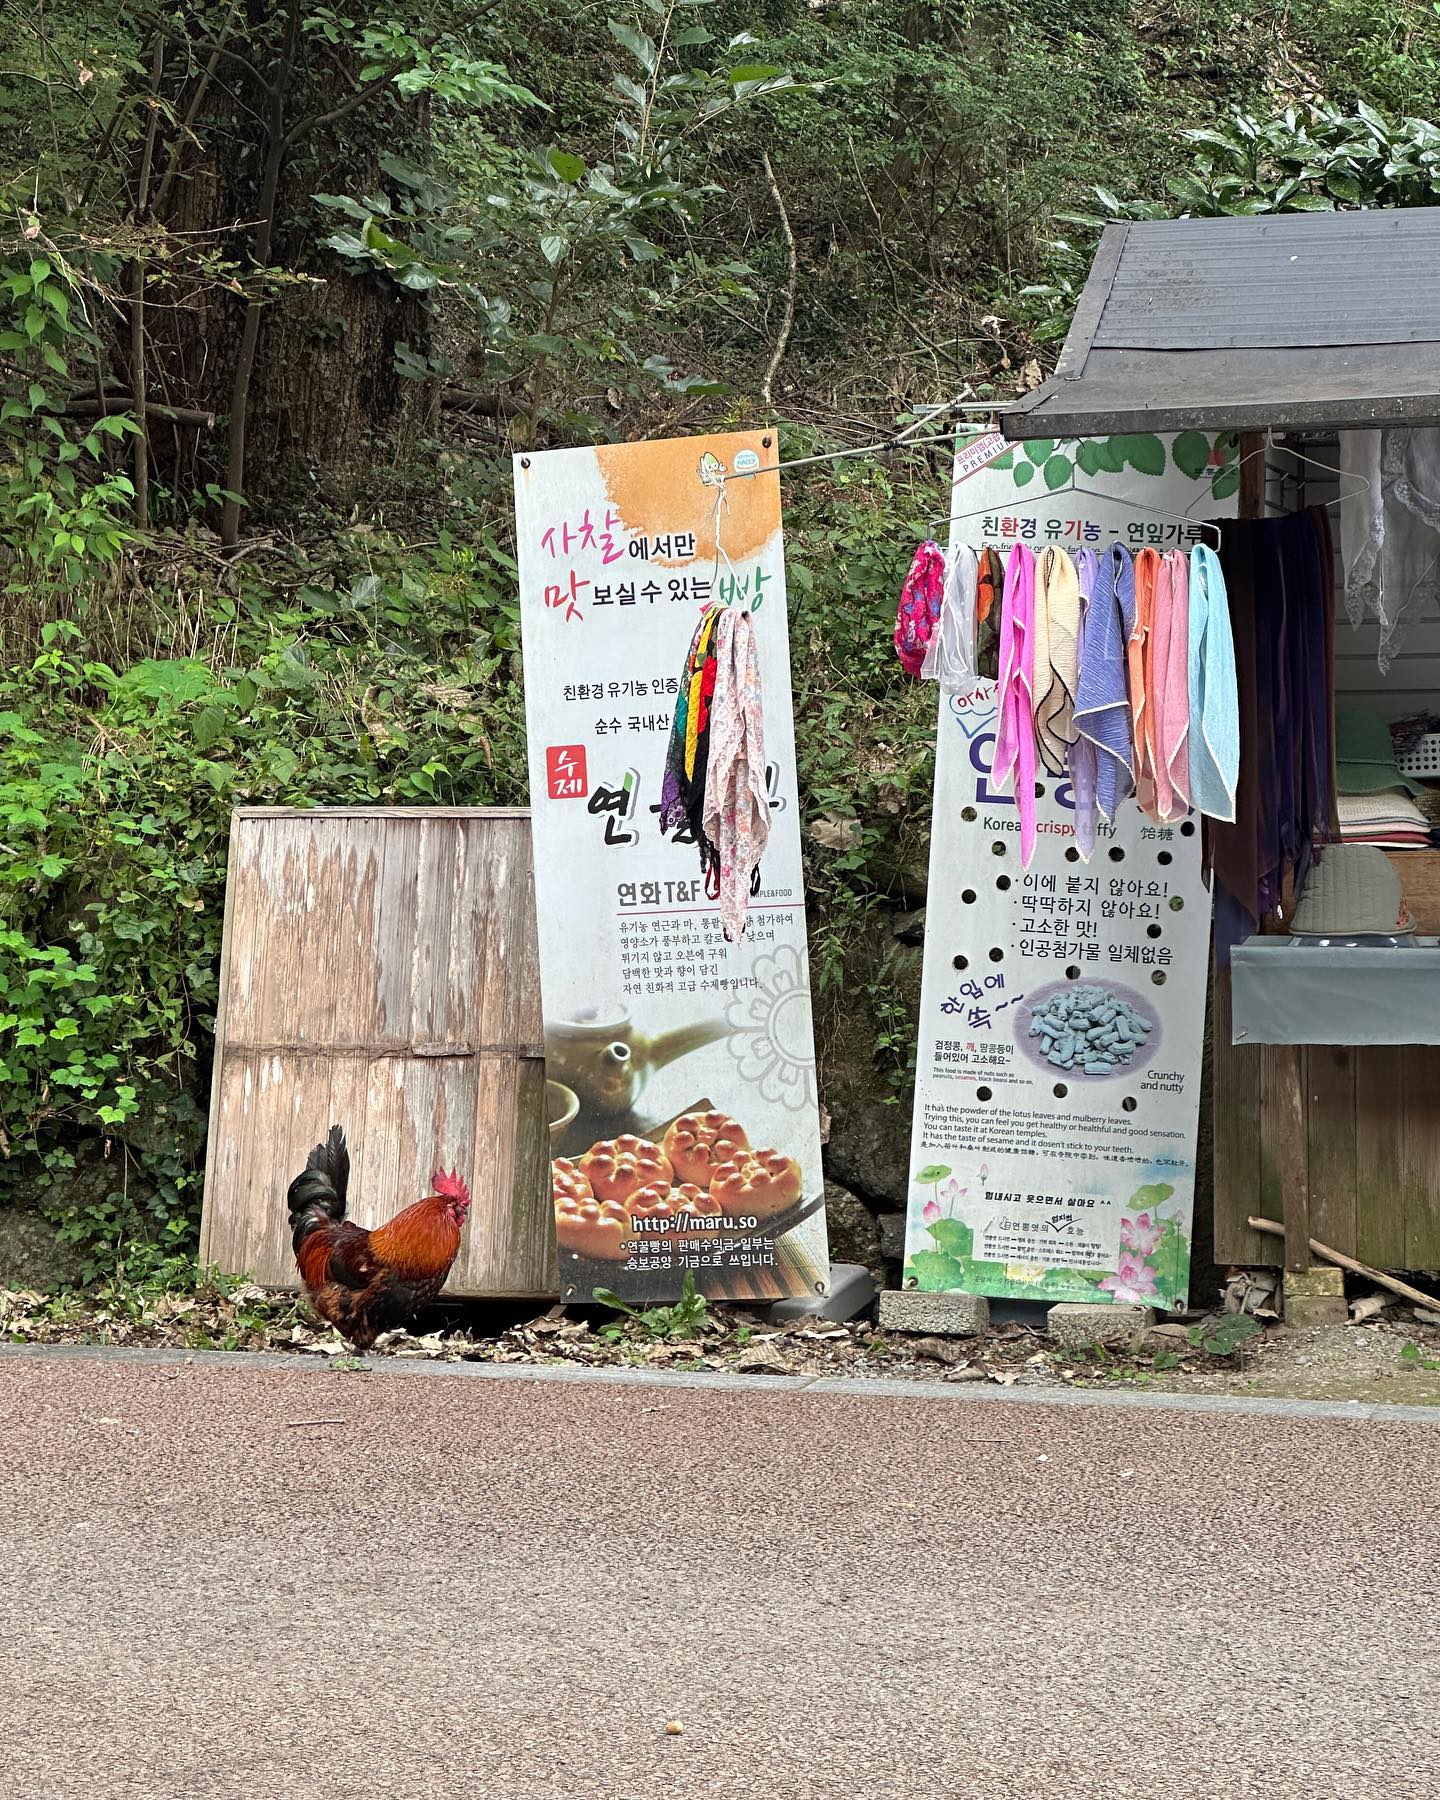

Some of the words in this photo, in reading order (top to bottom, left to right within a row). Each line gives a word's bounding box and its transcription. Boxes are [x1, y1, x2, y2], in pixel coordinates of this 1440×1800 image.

[981, 516, 1037, 539] 친환경
[1045, 517, 1101, 541] 유기농
[1127, 522, 1201, 545] 연잎가루
[544, 570, 591, 622] 맛
[719, 566, 772, 613] 빵
[563, 682, 604, 701] 친환경
[608, 681, 649, 698] 유기농
[652, 677, 679, 695] 인증
[595, 716, 622, 735] 순수
[628, 713, 669, 733] 국내산
[553, 750, 583, 795] 수제
[984, 816, 1022, 832] Korea
[1036, 819, 1075, 837] crispy
[1023, 873, 1057, 893] 이에
[1065, 875, 1099, 895] 붙지
[1110, 877, 1169, 898] 않아요!
[1022, 895, 1092, 917] 딱딱하지
[1101, 899, 1161, 920] 않아요!
[620, 921, 648, 933] 유기농
[652, 919, 680, 932] 연근과
[756, 913, 793, 927] 첨가하여
[1020, 917, 1069, 937] 고소한
[1076, 920, 1098, 939] 맛!
[620, 937, 658, 949] 영양소가
[662, 935, 701, 948] 풍부하고
[745, 930, 775, 943] 낮으며
[653, 950, 672, 961] 않고
[676, 948, 705, 961] 오븐에
[708, 947, 727, 960] 구워
[1020, 938, 1101, 961] 인공첨가물
[1108, 944, 1174, 965] 일체없음
[623, 967, 650, 980] 담백한
[654, 965, 673, 978] 맛과
[677, 964, 695, 977] 향이
[699, 963, 719, 976] 담긴
[623, 984, 642, 995] 자연
[645, 981, 674, 994] 친화적
[677, 980, 696, 992] 고급
[934, 1052, 968, 1063] 들어있어
[1147, 1070, 1185, 1082] Crunchy
[1140, 1082, 1159, 1091] and
[1161, 1082, 1184, 1093] nutty
[946, 1105, 959, 1113] the
[960, 1106, 988, 1115] powder
[990, 1107, 998, 1115] of
[999, 1108, 1011, 1117] the
[1012, 1109, 1031, 1118] lotus
[1033, 1111, 1055, 1120] leaves
[1072, 1114, 1107, 1124] mulberry
[924, 1113, 947, 1122] Trying
[965, 1116, 979, 1125] you
[995, 1118, 1009, 1126] feel
[1010, 1120, 1024, 1128] you
[1026, 1120, 1038, 1129] get
[1040, 1121, 1067, 1131] healthy
[1078, 1124, 1111, 1133] healthful
[1128, 1128, 1148, 1136] good
[973, 1125, 979, 1133] it
[989, 1126, 1014, 1135] Korean
[958, 1134, 976, 1142] taste
[978, 1135, 986, 1143] of
[987, 1137, 1014, 1145] sesame
[1015, 1138, 1030, 1146] and
[1067, 1197, 1095, 1208] 살아요
[632, 1213, 757, 1233] http://maru.so
[627, 1240, 672, 1254] 연꿀빵의
[678, 1238, 735, 1252] 판매수익금
[740, 1237, 775, 1250] 일부는
[627, 1256, 672, 1270] 승보공양
[678, 1254, 724, 1268] 기금으로
[729, 1253, 779, 1266] 쓰입니다.
